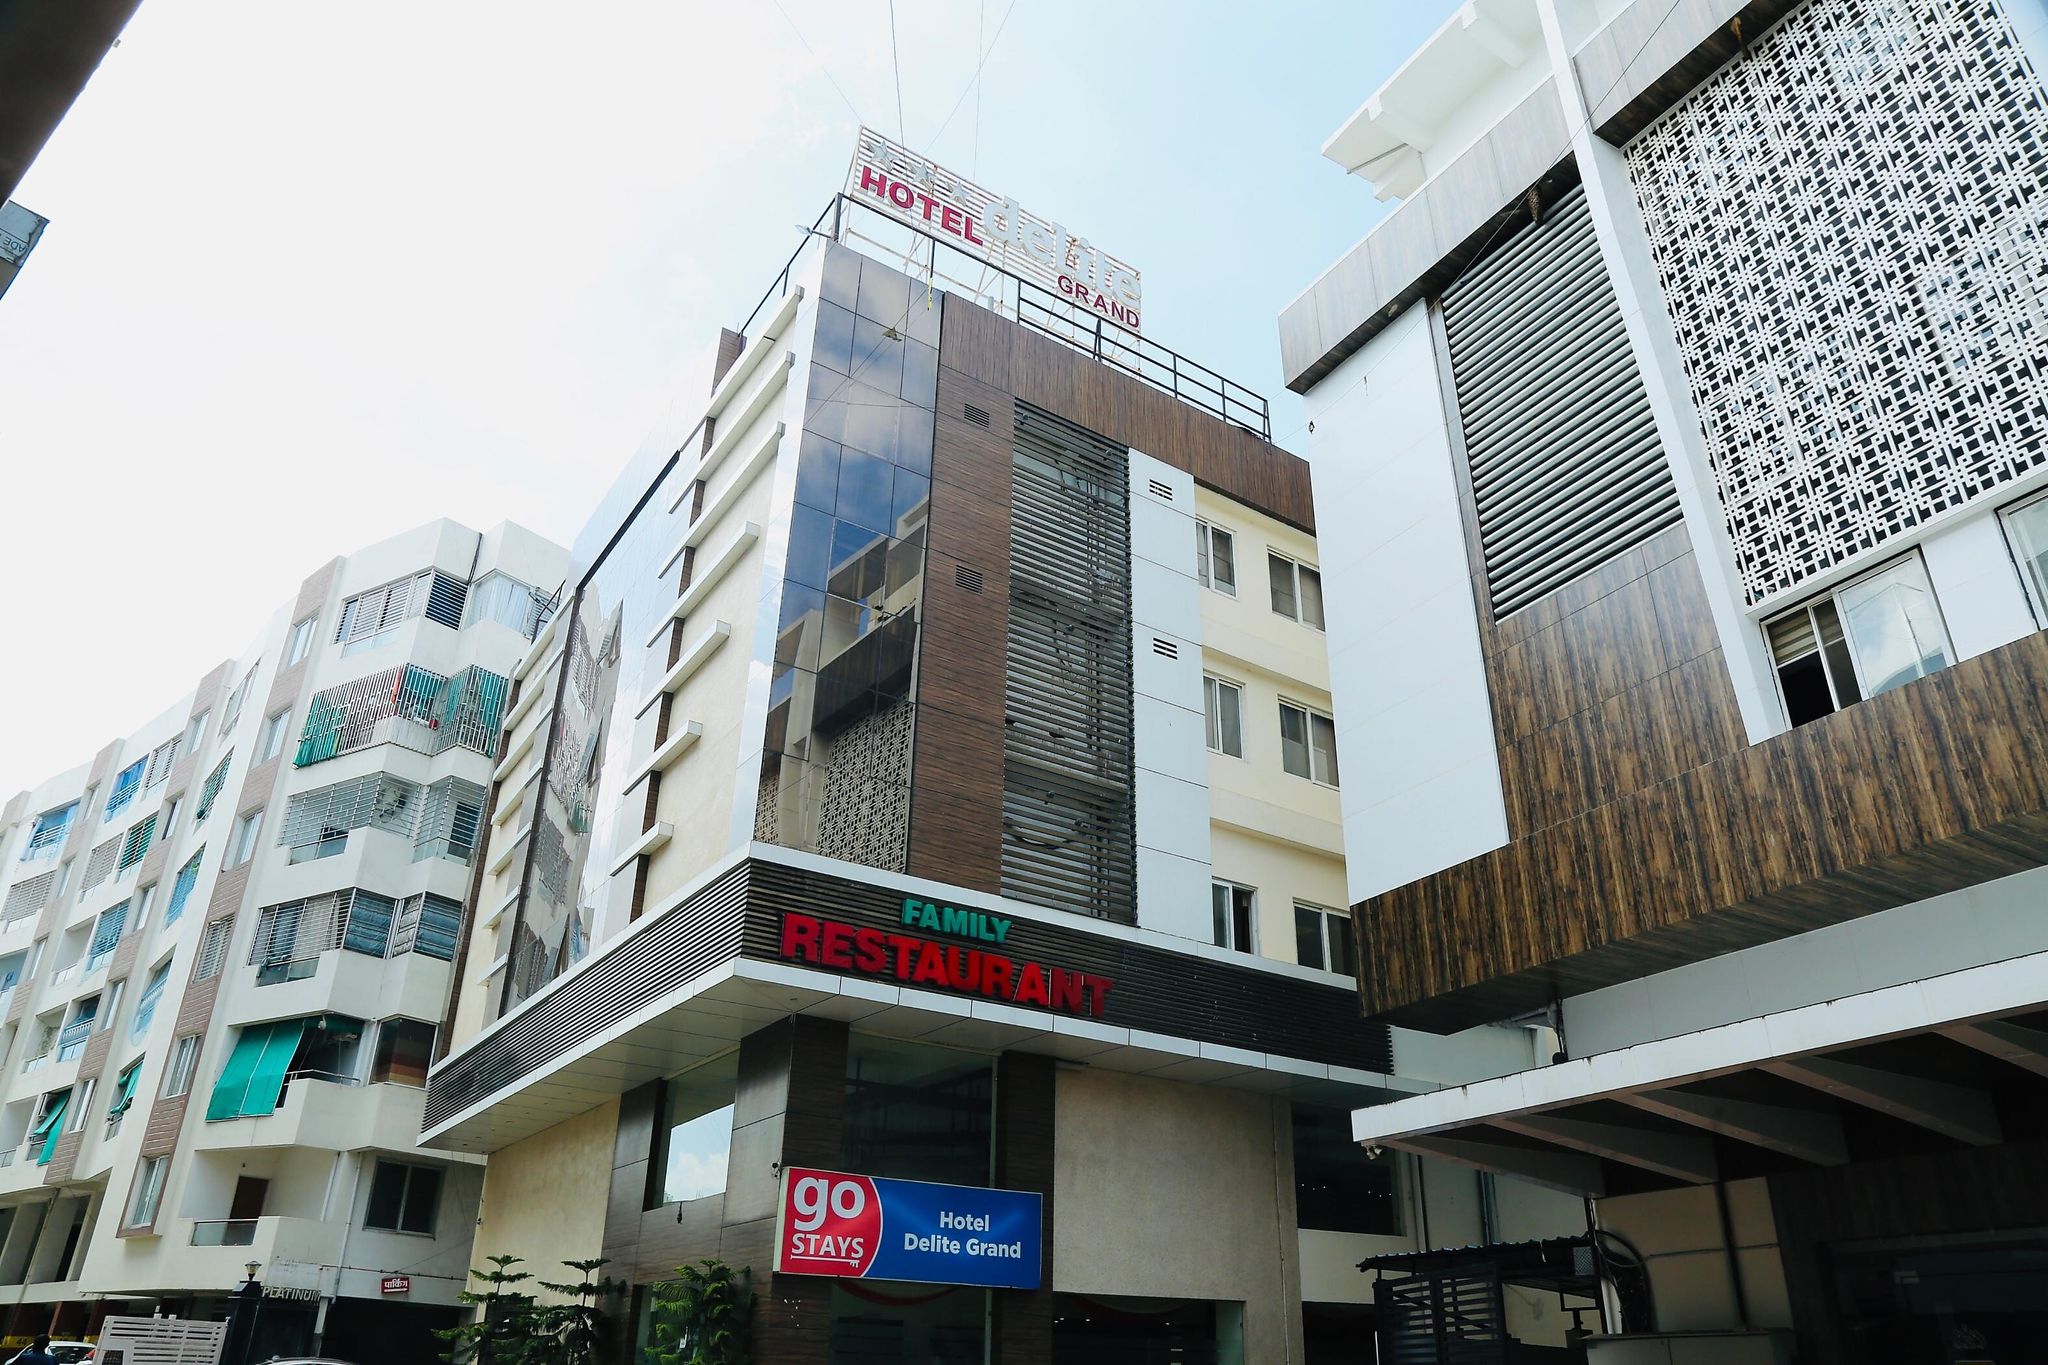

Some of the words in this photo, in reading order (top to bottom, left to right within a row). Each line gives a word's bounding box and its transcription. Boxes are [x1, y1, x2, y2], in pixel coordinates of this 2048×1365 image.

[860, 165, 984, 247] HOTEL
[1057, 274, 1140, 330] GRAND
[901, 898, 1012, 943] FAMILY
[780, 912, 1114, 1018] RESTAURANT
[793, 1176, 865, 1232] go
[939, 1211, 990, 1232] Hotel
[791, 1233, 864, 1259] STAYS
[904, 1232, 961, 1255] Delite
[966, 1238, 1021, 1259] Grand
[262, 1286, 321, 1301] PLATINUM
